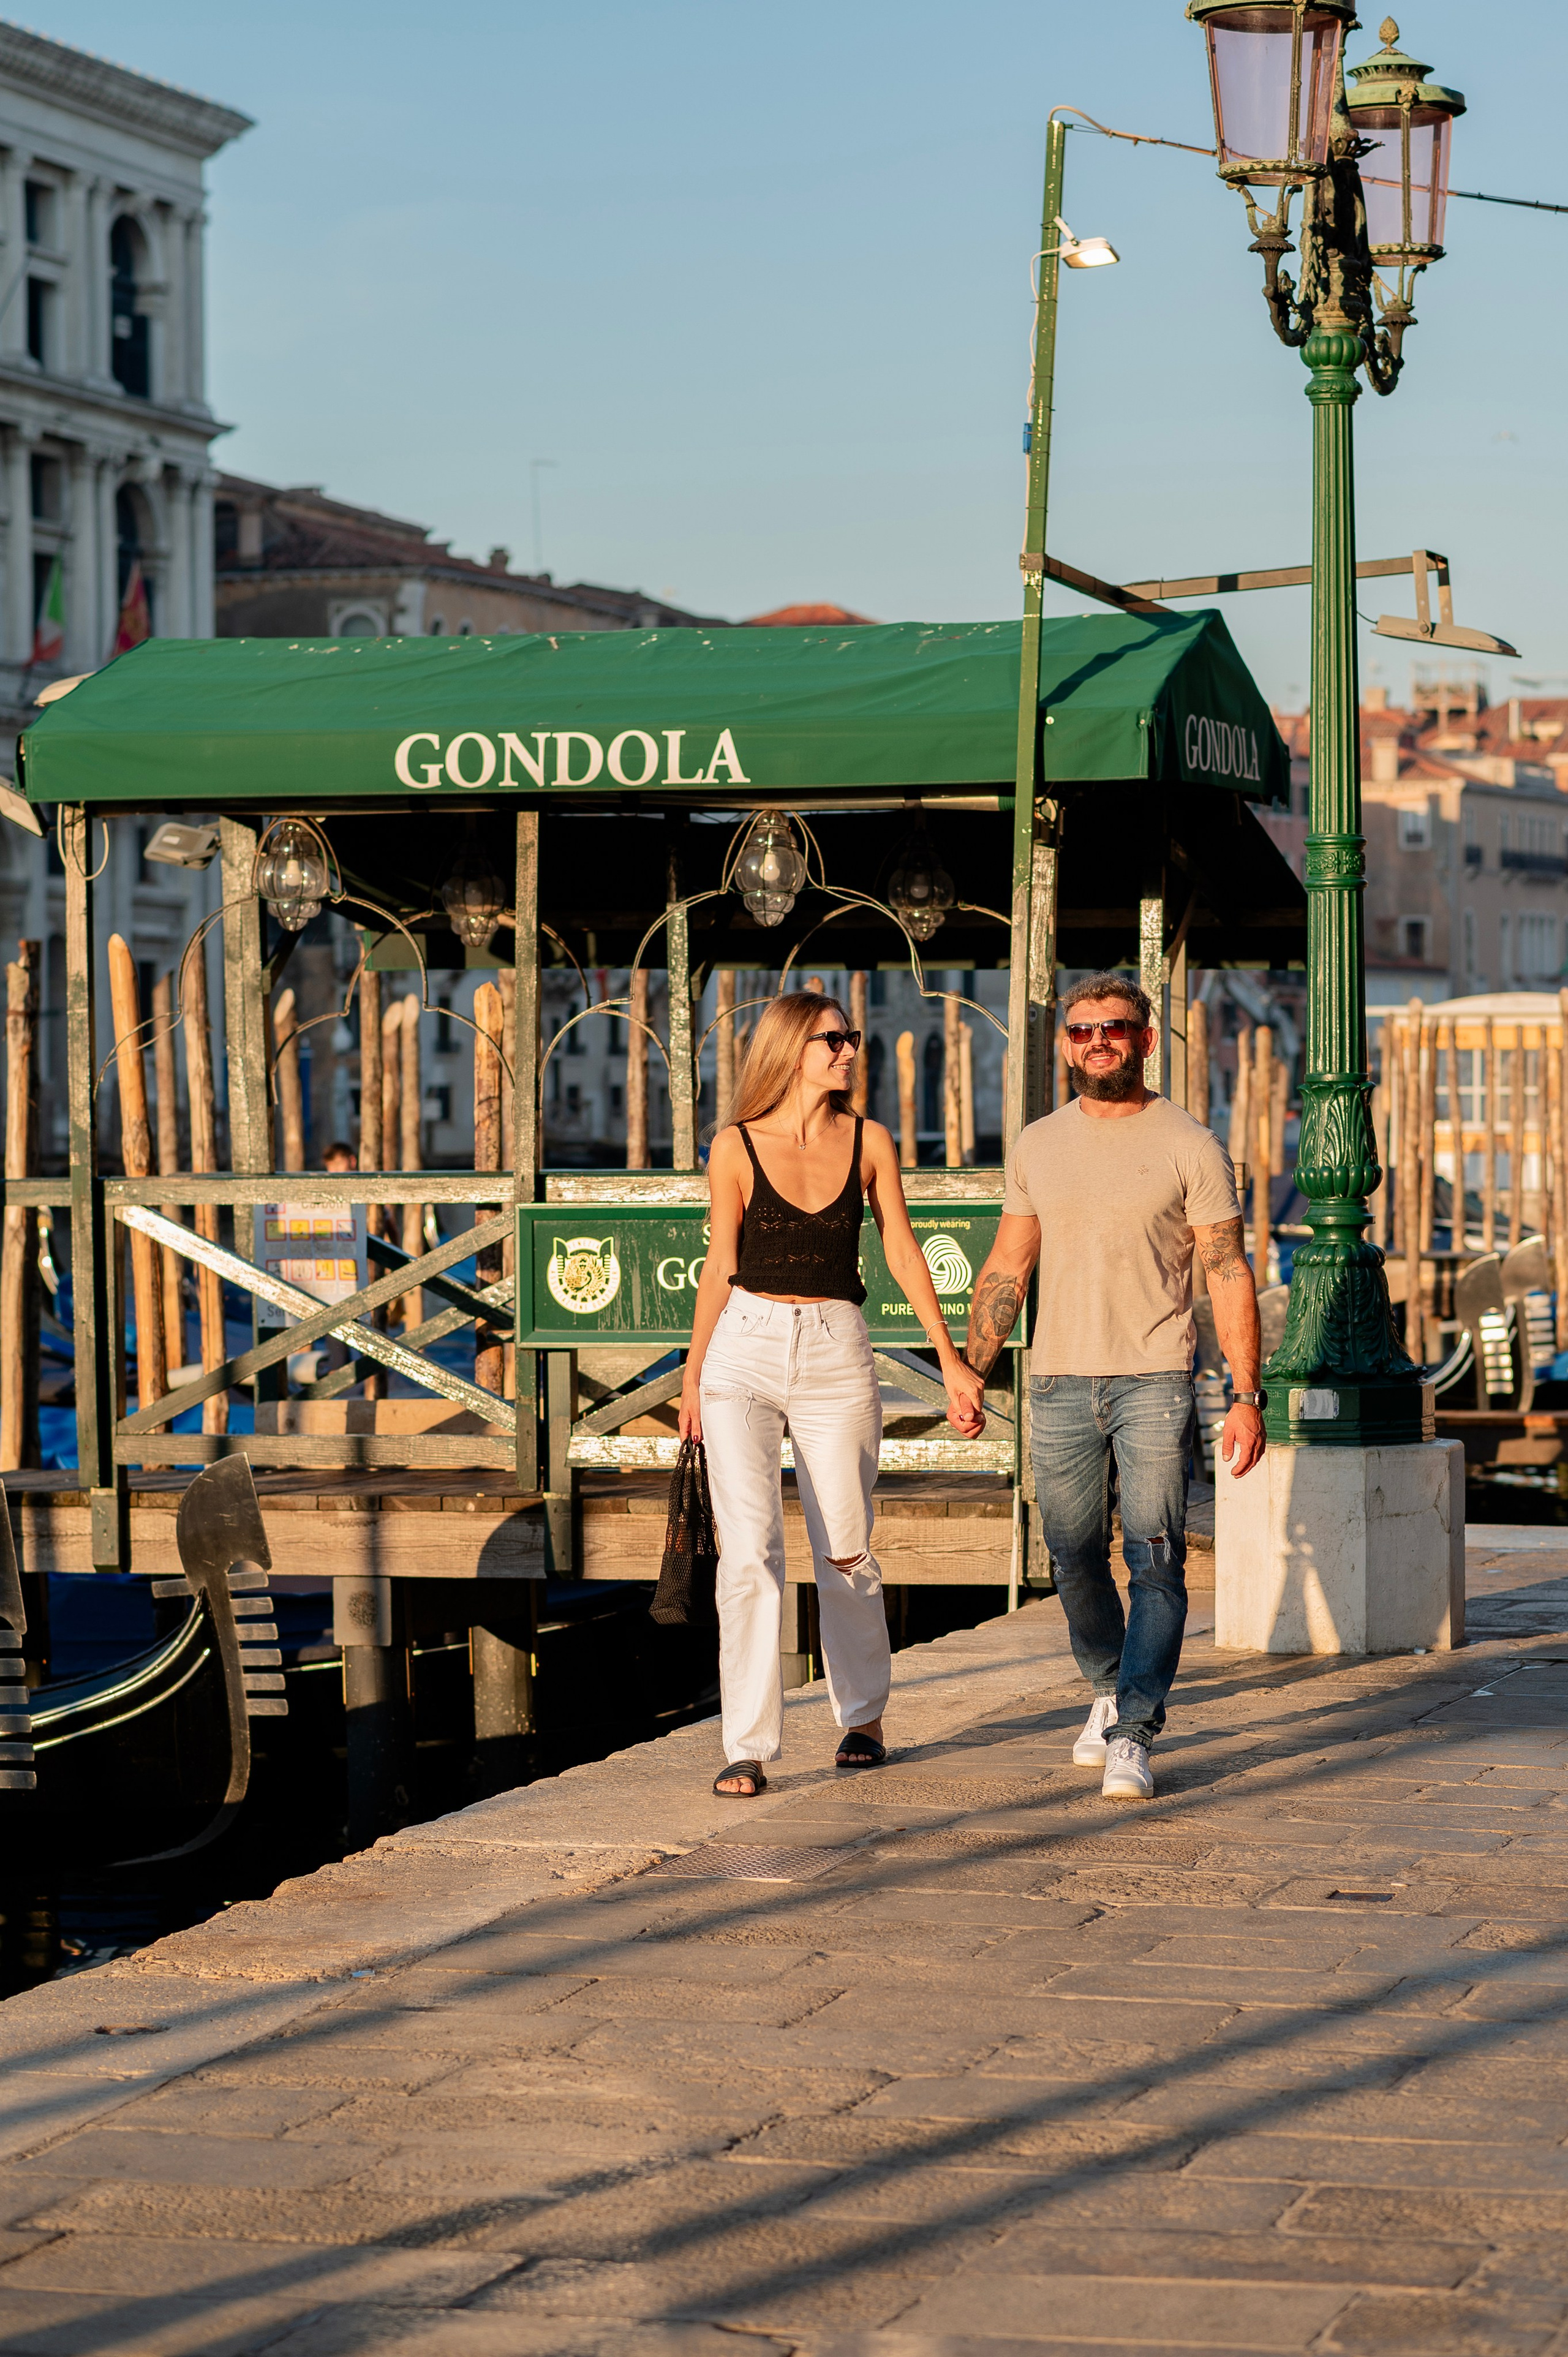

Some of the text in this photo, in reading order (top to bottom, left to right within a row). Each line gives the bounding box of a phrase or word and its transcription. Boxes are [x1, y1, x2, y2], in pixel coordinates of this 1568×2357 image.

[394, 728, 752, 790] GONDOLA
[1185, 714, 1261, 781] GONDOLA
[911, 1220, 970, 1230] proudly wearing
[881, 1303, 914, 1316] PURE
